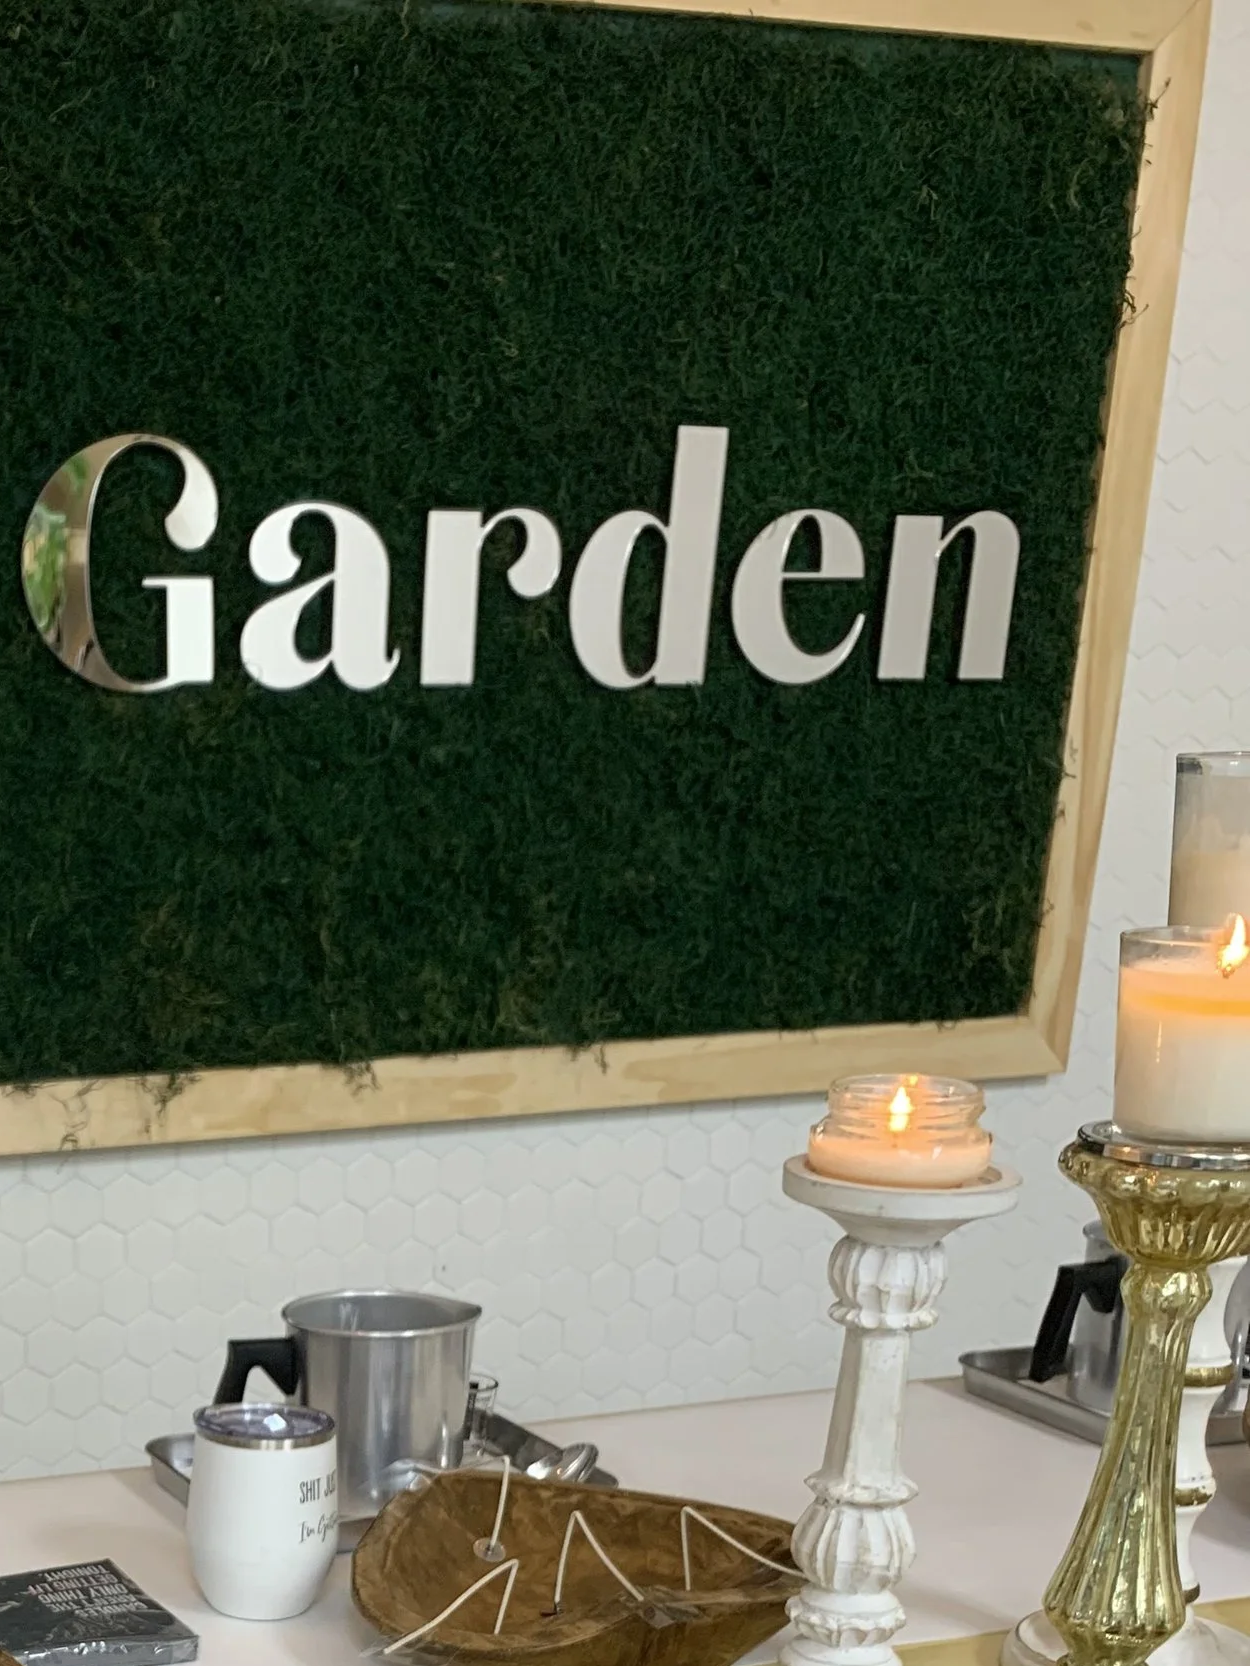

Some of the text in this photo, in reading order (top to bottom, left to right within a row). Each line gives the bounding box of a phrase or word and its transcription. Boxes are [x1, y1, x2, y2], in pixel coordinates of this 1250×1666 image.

[20, 425, 1021, 694] Garden
[299, 1477, 321, 1504] SHIT
[37, 1583, 129, 1605] ONLY THING
[52, 1573, 119, 1592] GETTING
